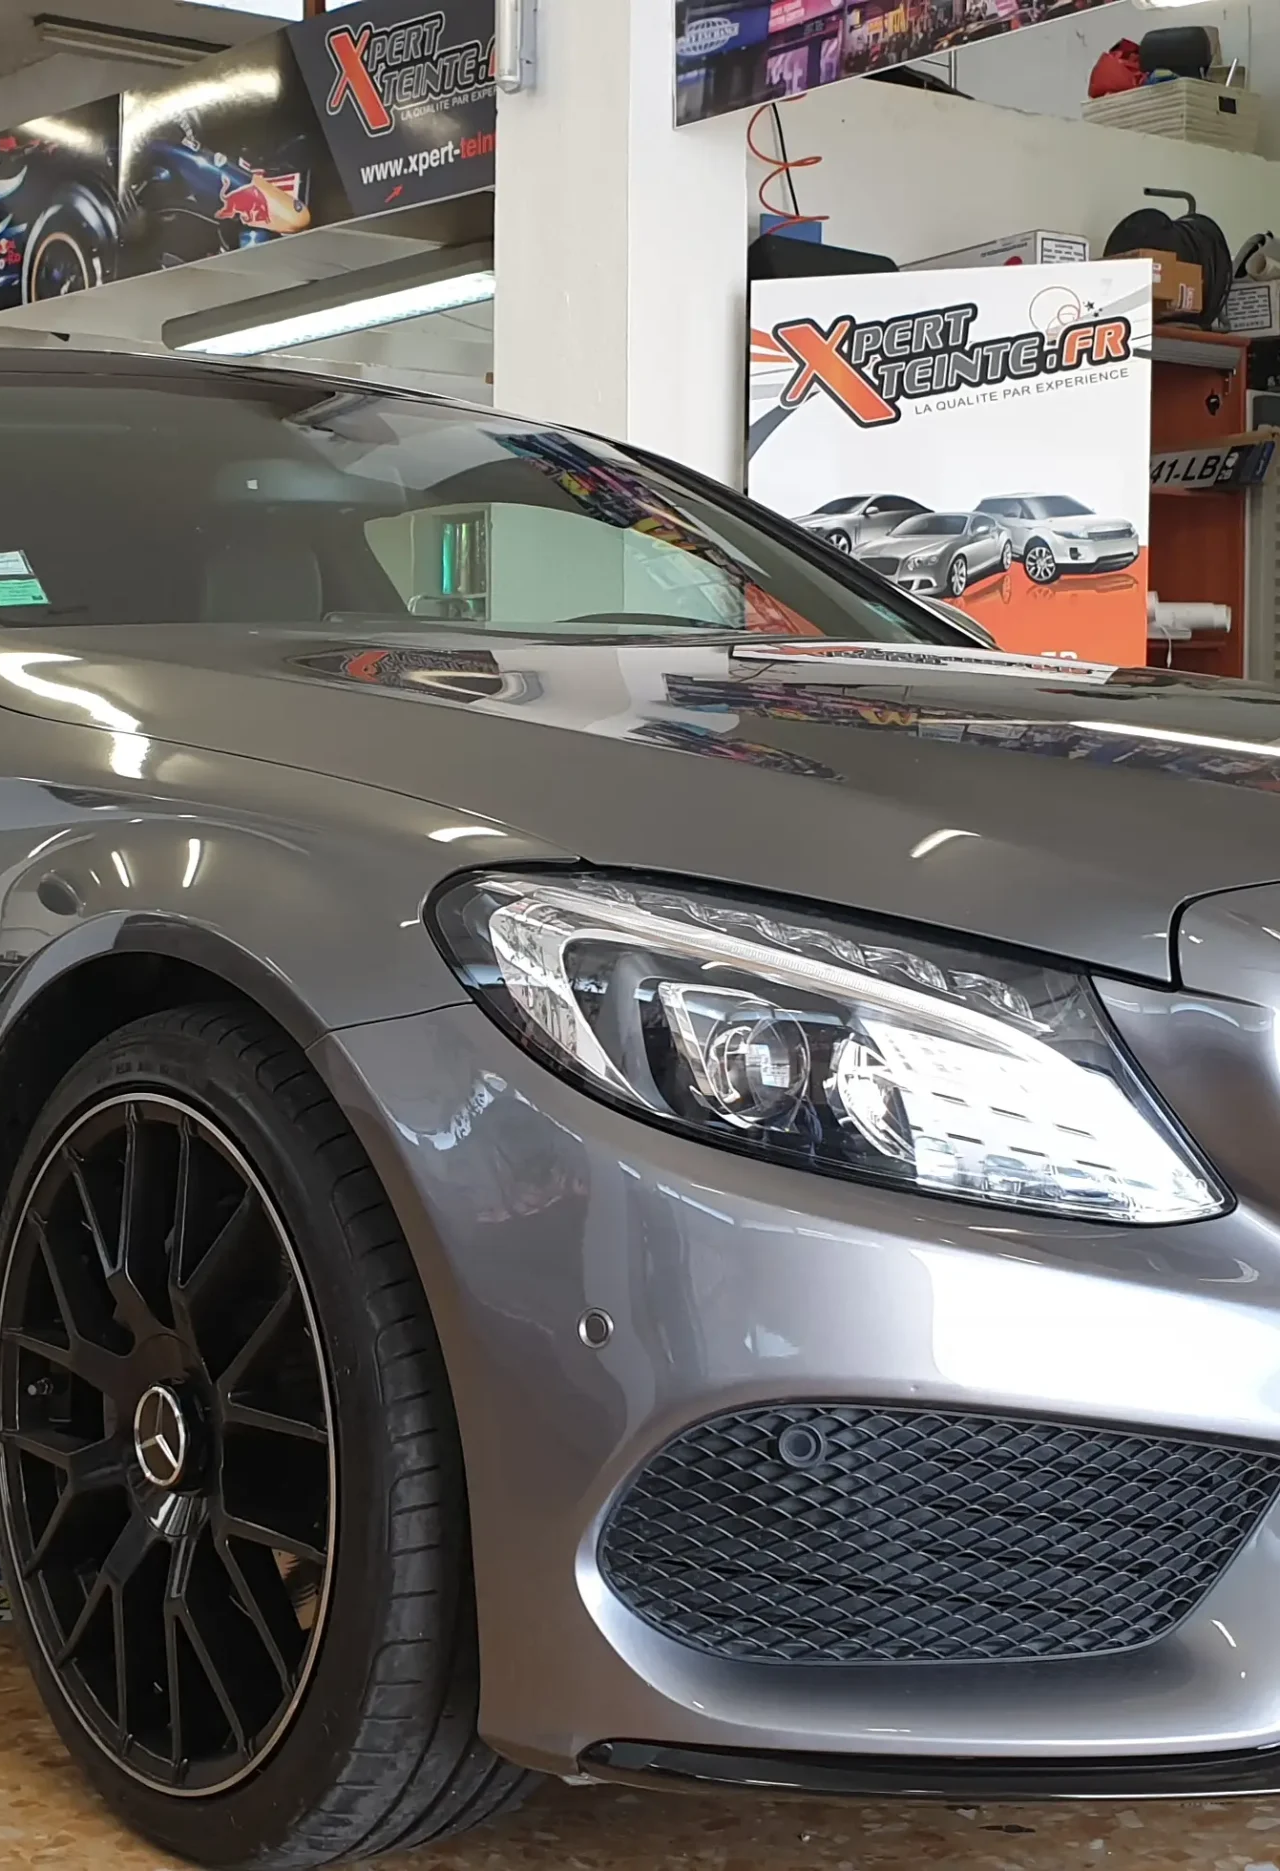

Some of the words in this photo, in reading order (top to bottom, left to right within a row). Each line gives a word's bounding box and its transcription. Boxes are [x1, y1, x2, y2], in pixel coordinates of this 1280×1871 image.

[401, 110, 412, 121] LA
[452, 94, 469, 107] PAR
[361, 131, 497, 185] www.xpert-tein
[777, 307, 972, 424] XPERT
[878, 320, 1127, 400] TEINTE.FR
[914, 404, 932, 416] LA
[936, 391, 999, 412] QUALITE
[1003, 385, 1031, 401] PAR
[1036, 367, 1130, 394] EXPERIENCE
